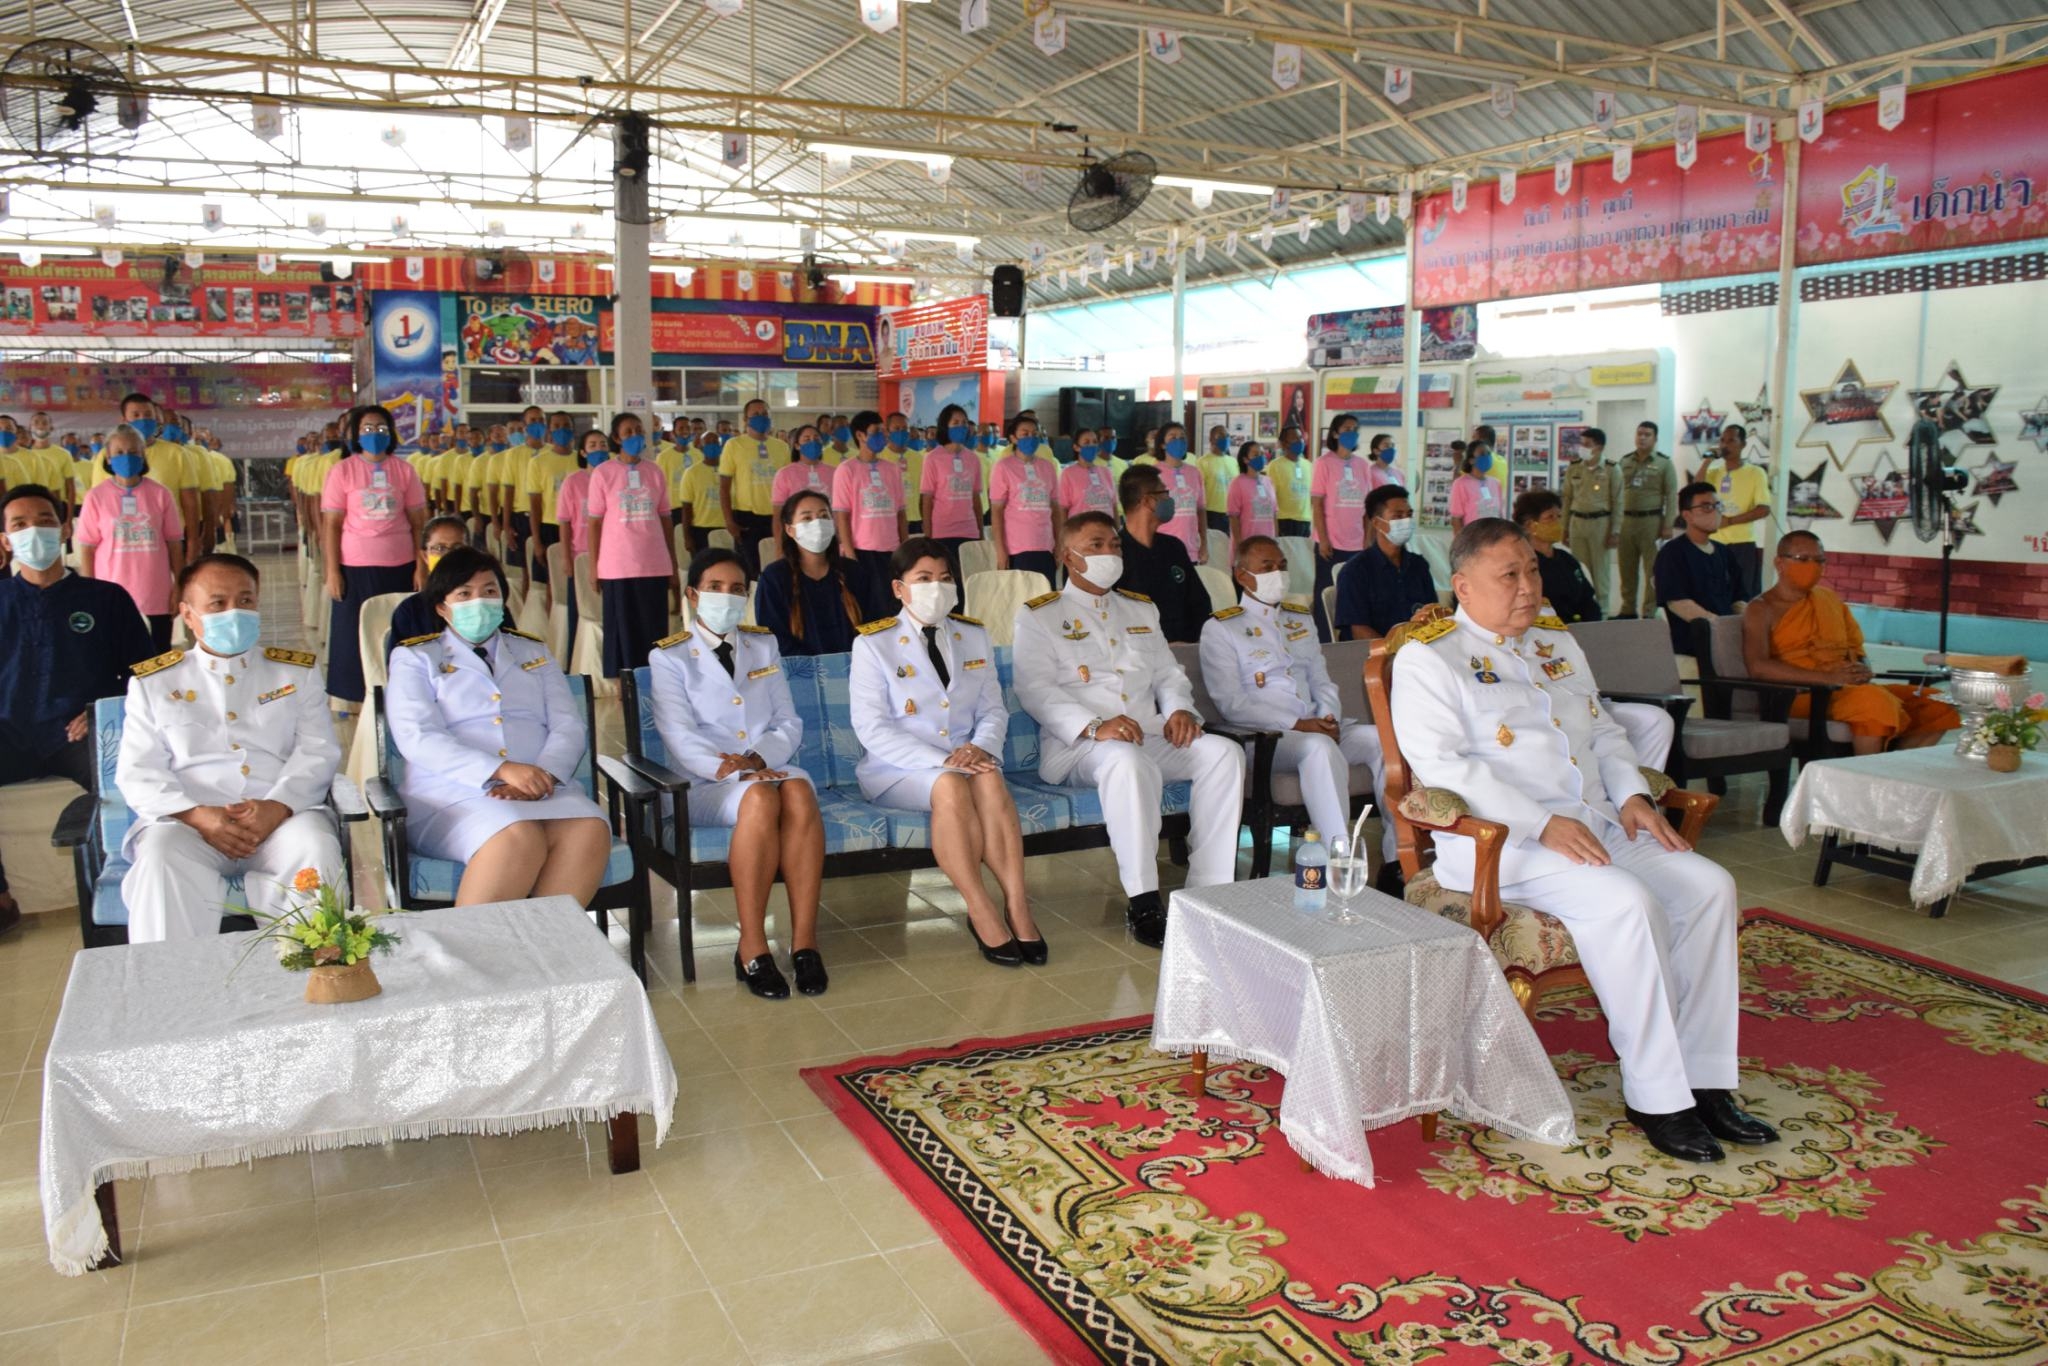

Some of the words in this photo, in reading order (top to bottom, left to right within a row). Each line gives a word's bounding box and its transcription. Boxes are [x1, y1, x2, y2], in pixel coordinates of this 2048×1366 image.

[1912, 171, 2031, 222] เด็กนำ
[460, 296, 487, 314] TO
[491, 297, 511, 314] BE
[530, 296, 593, 314] HERO
[399, 314, 410, 338] 1
[785, 323, 873, 361] DNA
